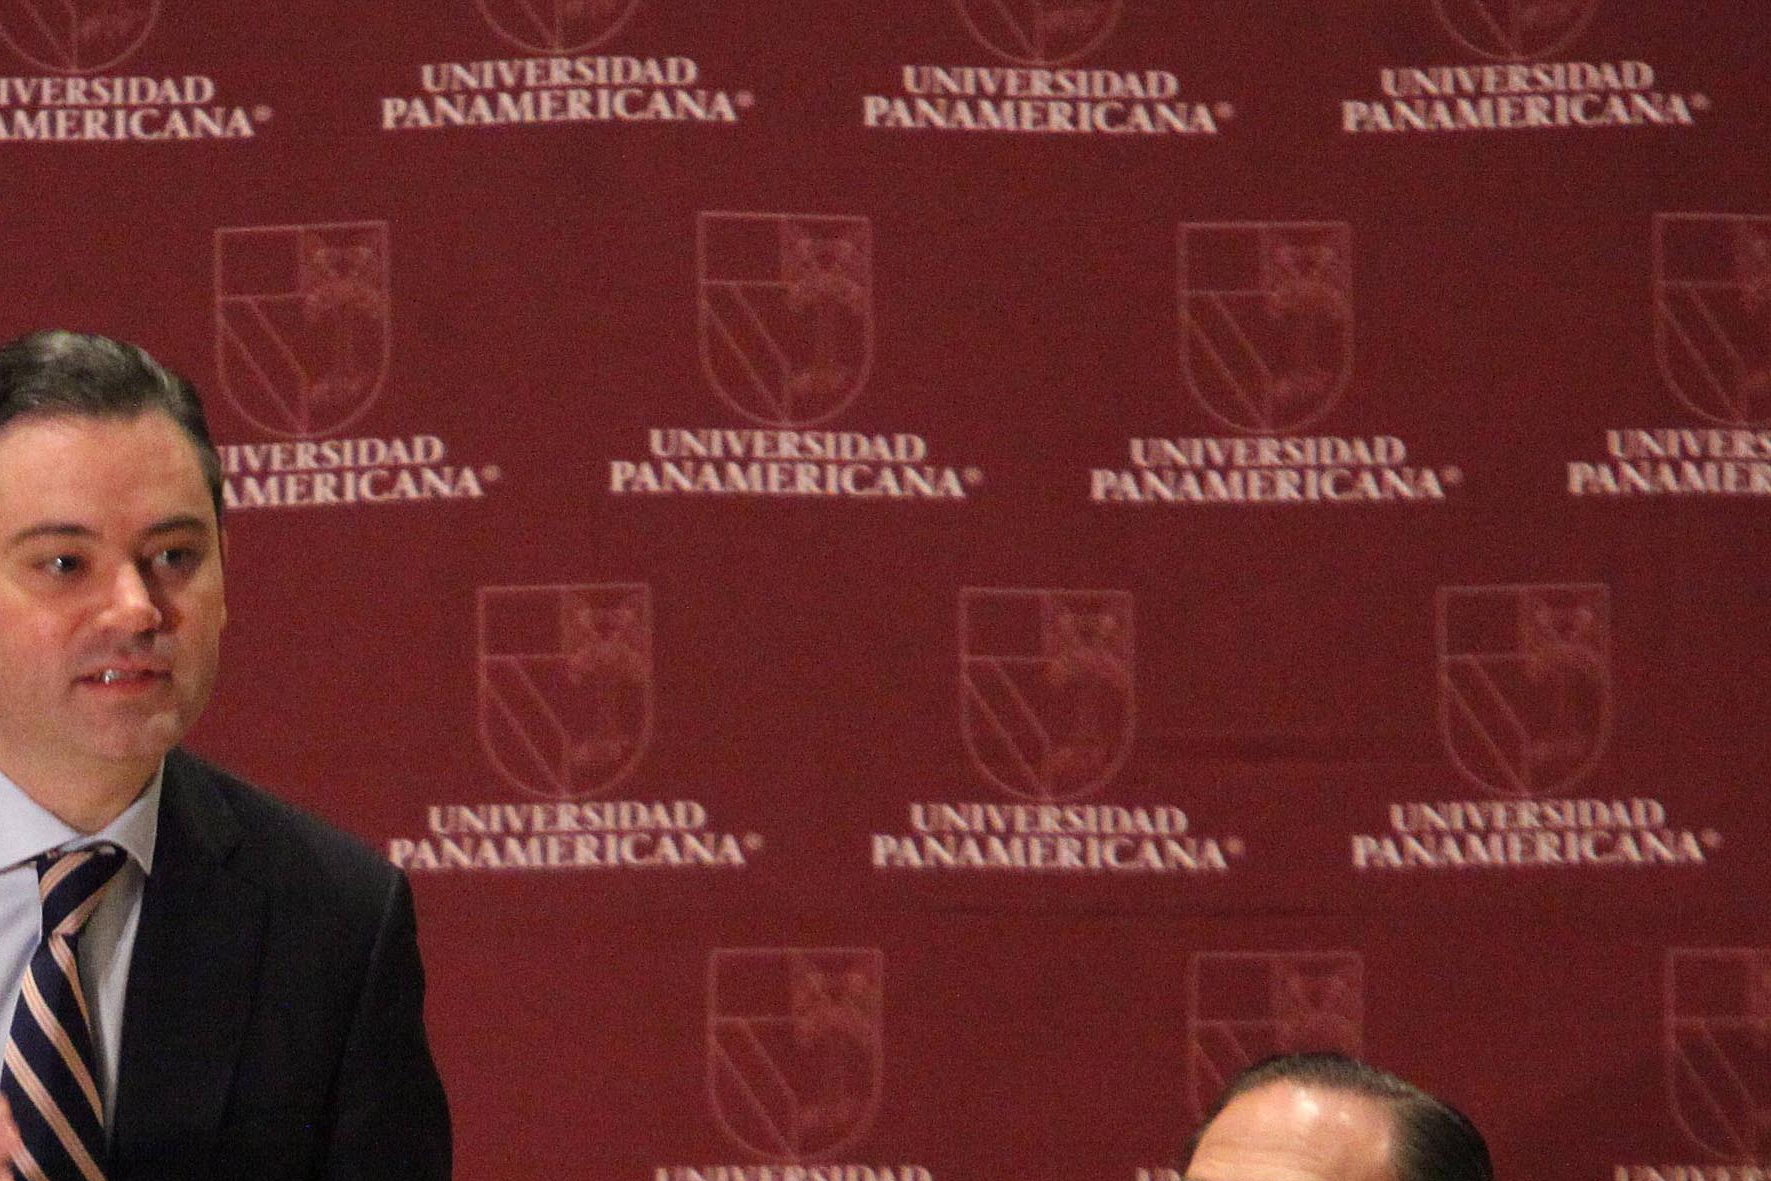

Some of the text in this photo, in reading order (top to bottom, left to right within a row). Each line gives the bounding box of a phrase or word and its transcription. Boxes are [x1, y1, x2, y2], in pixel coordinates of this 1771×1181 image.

[420, 57, 700, 94] UNIVERSIDAD
[902, 64, 1180, 101] UNIVERSIDAD
[1380, 61, 1656, 98] UNIVERSIDAD
[381, 87, 739, 129] PANAMERICANA
[862, 94, 1219, 134] PANAMERICANA
[1341, 90, 1695, 133] PANAMERICANA
[648, 429, 927, 464] UNIVERSIDAD
[1129, 437, 1407, 470] UNIVERSIDAD
[221, 465, 484, 510] AMERICANA
[610, 460, 967, 498] PANAMERICANA
[1089, 467, 1446, 502] PANAMERICANA
[429, 801, 708, 833] UNIVERSIDAD
[910, 802, 1190, 838] UNIVERSIDAD
[1389, 798, 1667, 836] UNIVERSIDAD
[871, 833, 1229, 873] PANAMERICANA
[1351, 831, 1706, 872] PANAMERICANA
